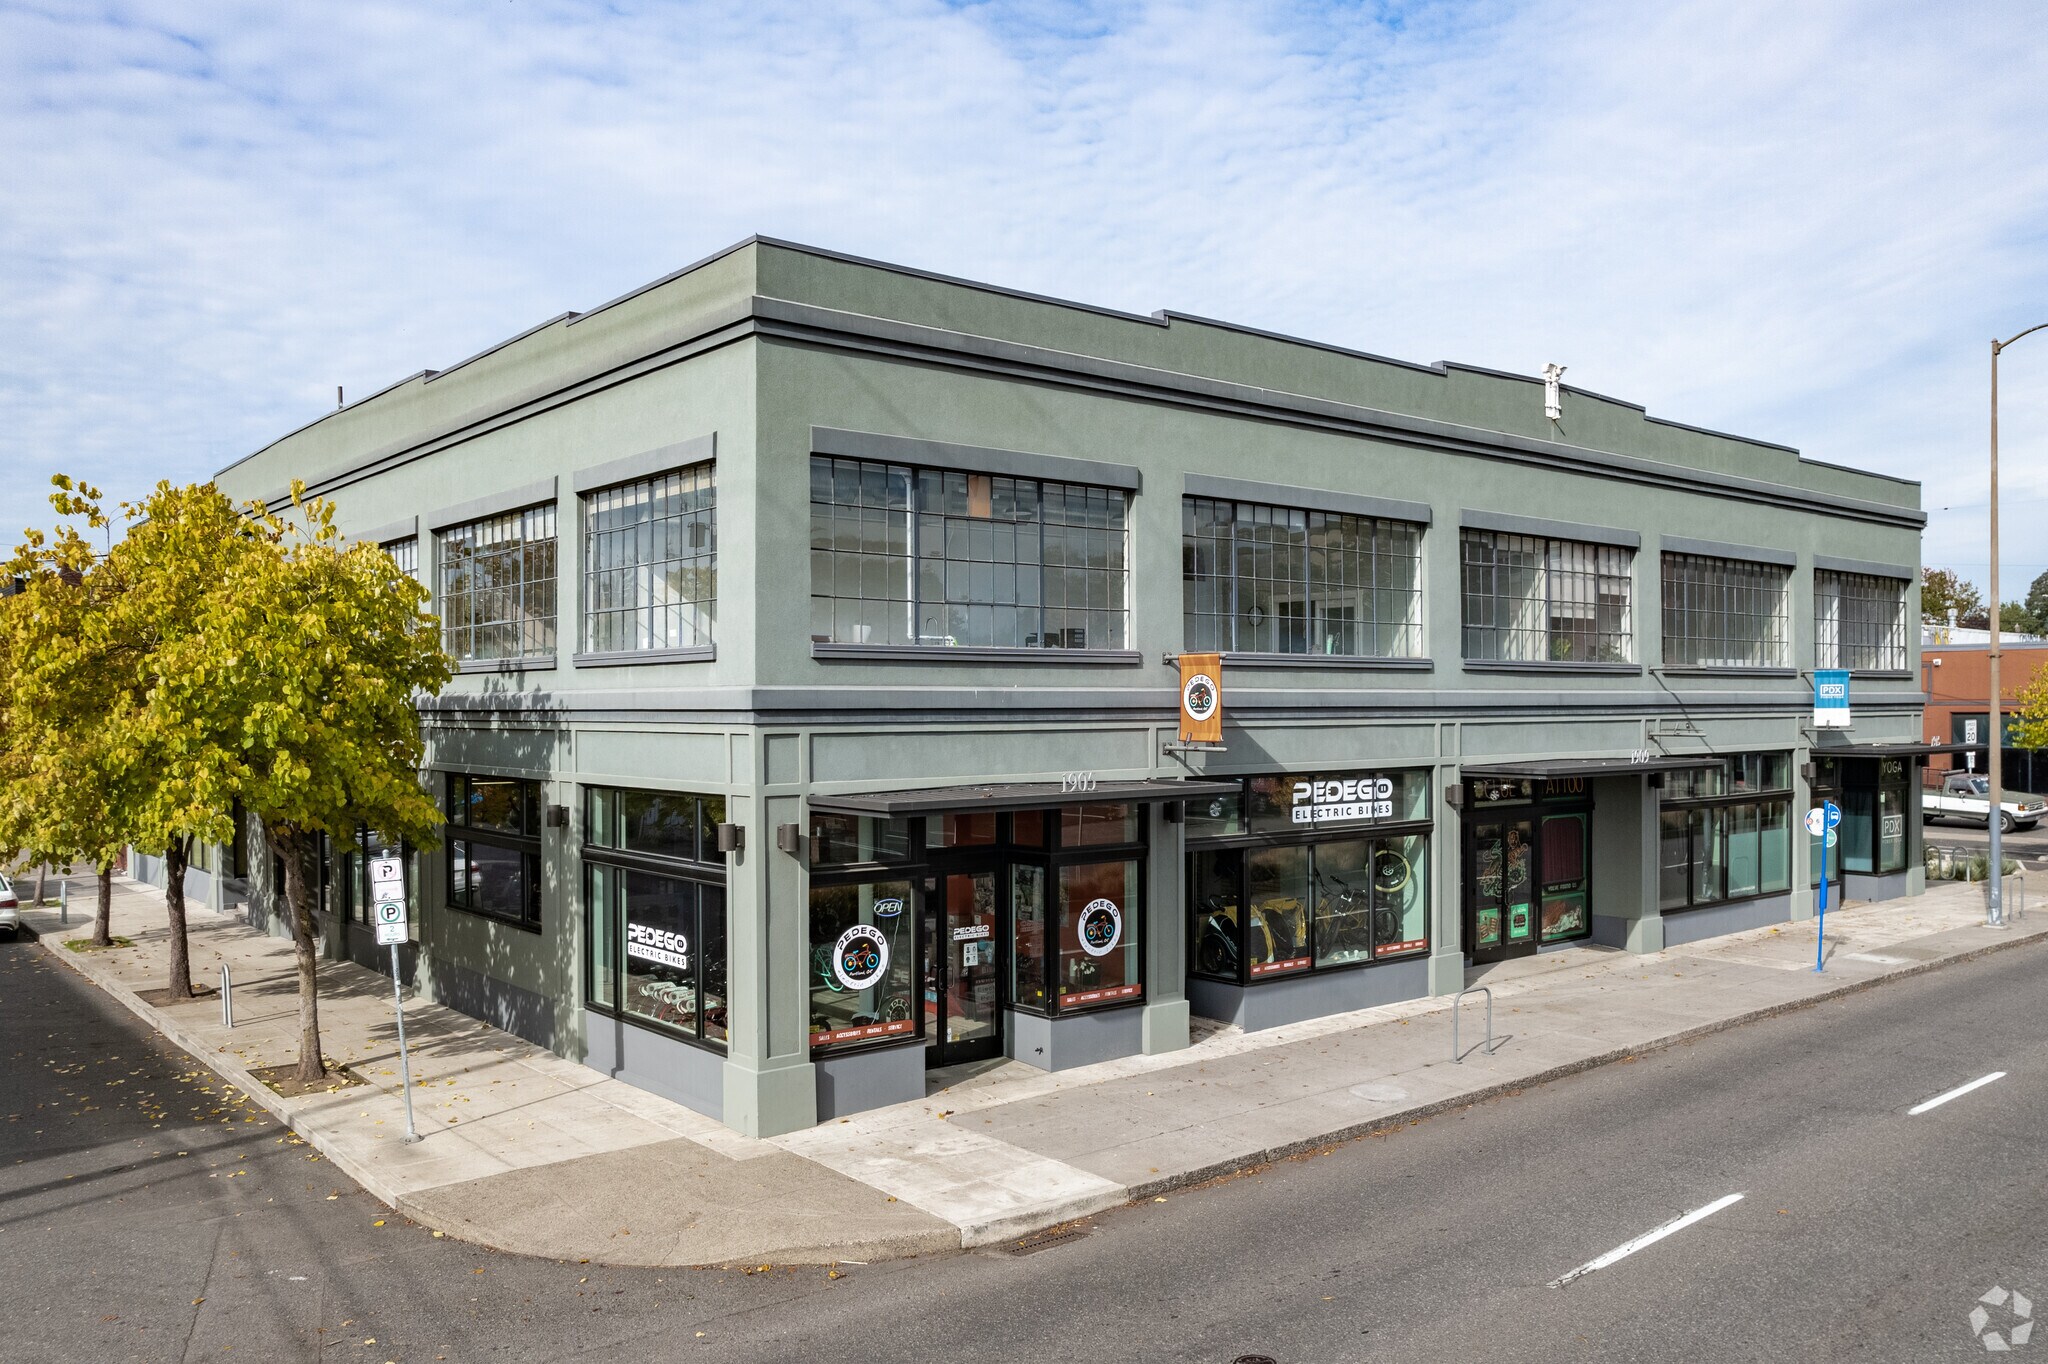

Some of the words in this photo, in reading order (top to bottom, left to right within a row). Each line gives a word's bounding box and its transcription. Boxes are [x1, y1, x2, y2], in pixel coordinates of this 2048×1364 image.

[1186, 676, 1215, 691] PEDEGO
[1966, 732, 1976, 741] 20
[1630, 750, 1649, 764] 1909
[1882, 761, 1902, 773] YOGA
[1060, 772, 1096, 792] 1905
[1292, 778, 1393, 804] PEDEGO
[1295, 806, 1352, 820] ELECTRIC
[1358, 804, 1390, 815] BIKES
[1884, 819, 1900, 834] PDX
[386, 908, 396, 919] P
[874, 902, 904, 912] OPEN
[1081, 900, 1118, 920] PEDEGO
[954, 924, 990, 935] PEDEGO
[627, 923, 688, 954] PEDEGO
[838, 927, 884, 950] PEDEGO
[629, 945, 662, 960] ELECTRIC
[664, 954, 686, 966] BIKES
